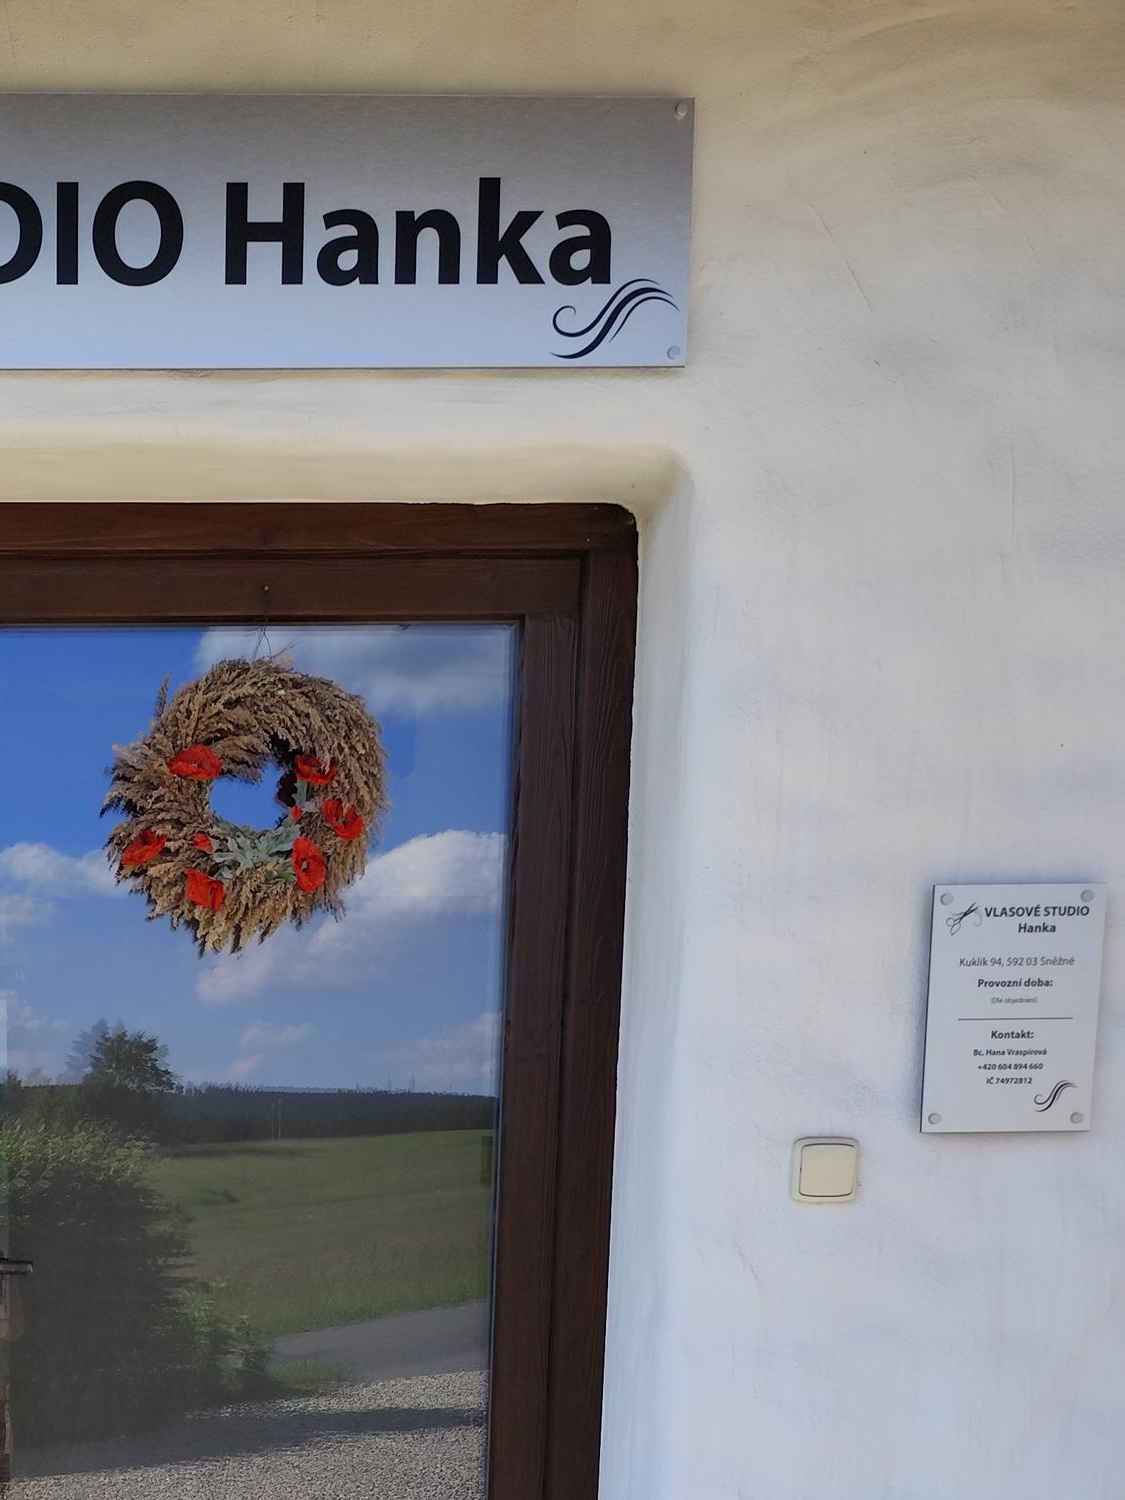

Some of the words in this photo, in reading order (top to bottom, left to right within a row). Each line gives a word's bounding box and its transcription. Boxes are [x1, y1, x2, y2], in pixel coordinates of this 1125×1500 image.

[224, 177, 613, 287] Hanka
[984, 904, 1041, 917] VLASOVÉ
[1043, 906, 1090, 917] STUDIO
[1018, 923, 1057, 933] Hanka
[959, 957, 988, 967] Kuklík
[990, 958, 1004, 967] 94,
[1006, 957, 1024, 966] 592
[1026, 957, 1037, 966] 03
[977, 978, 1022, 988] Provozní
[1024, 978, 1053, 987] doba:
[991, 1030, 1034, 1039] Kontakt:
[986, 1048, 1005, 1056] Hana
[978, 1063, 997, 1071] +420
